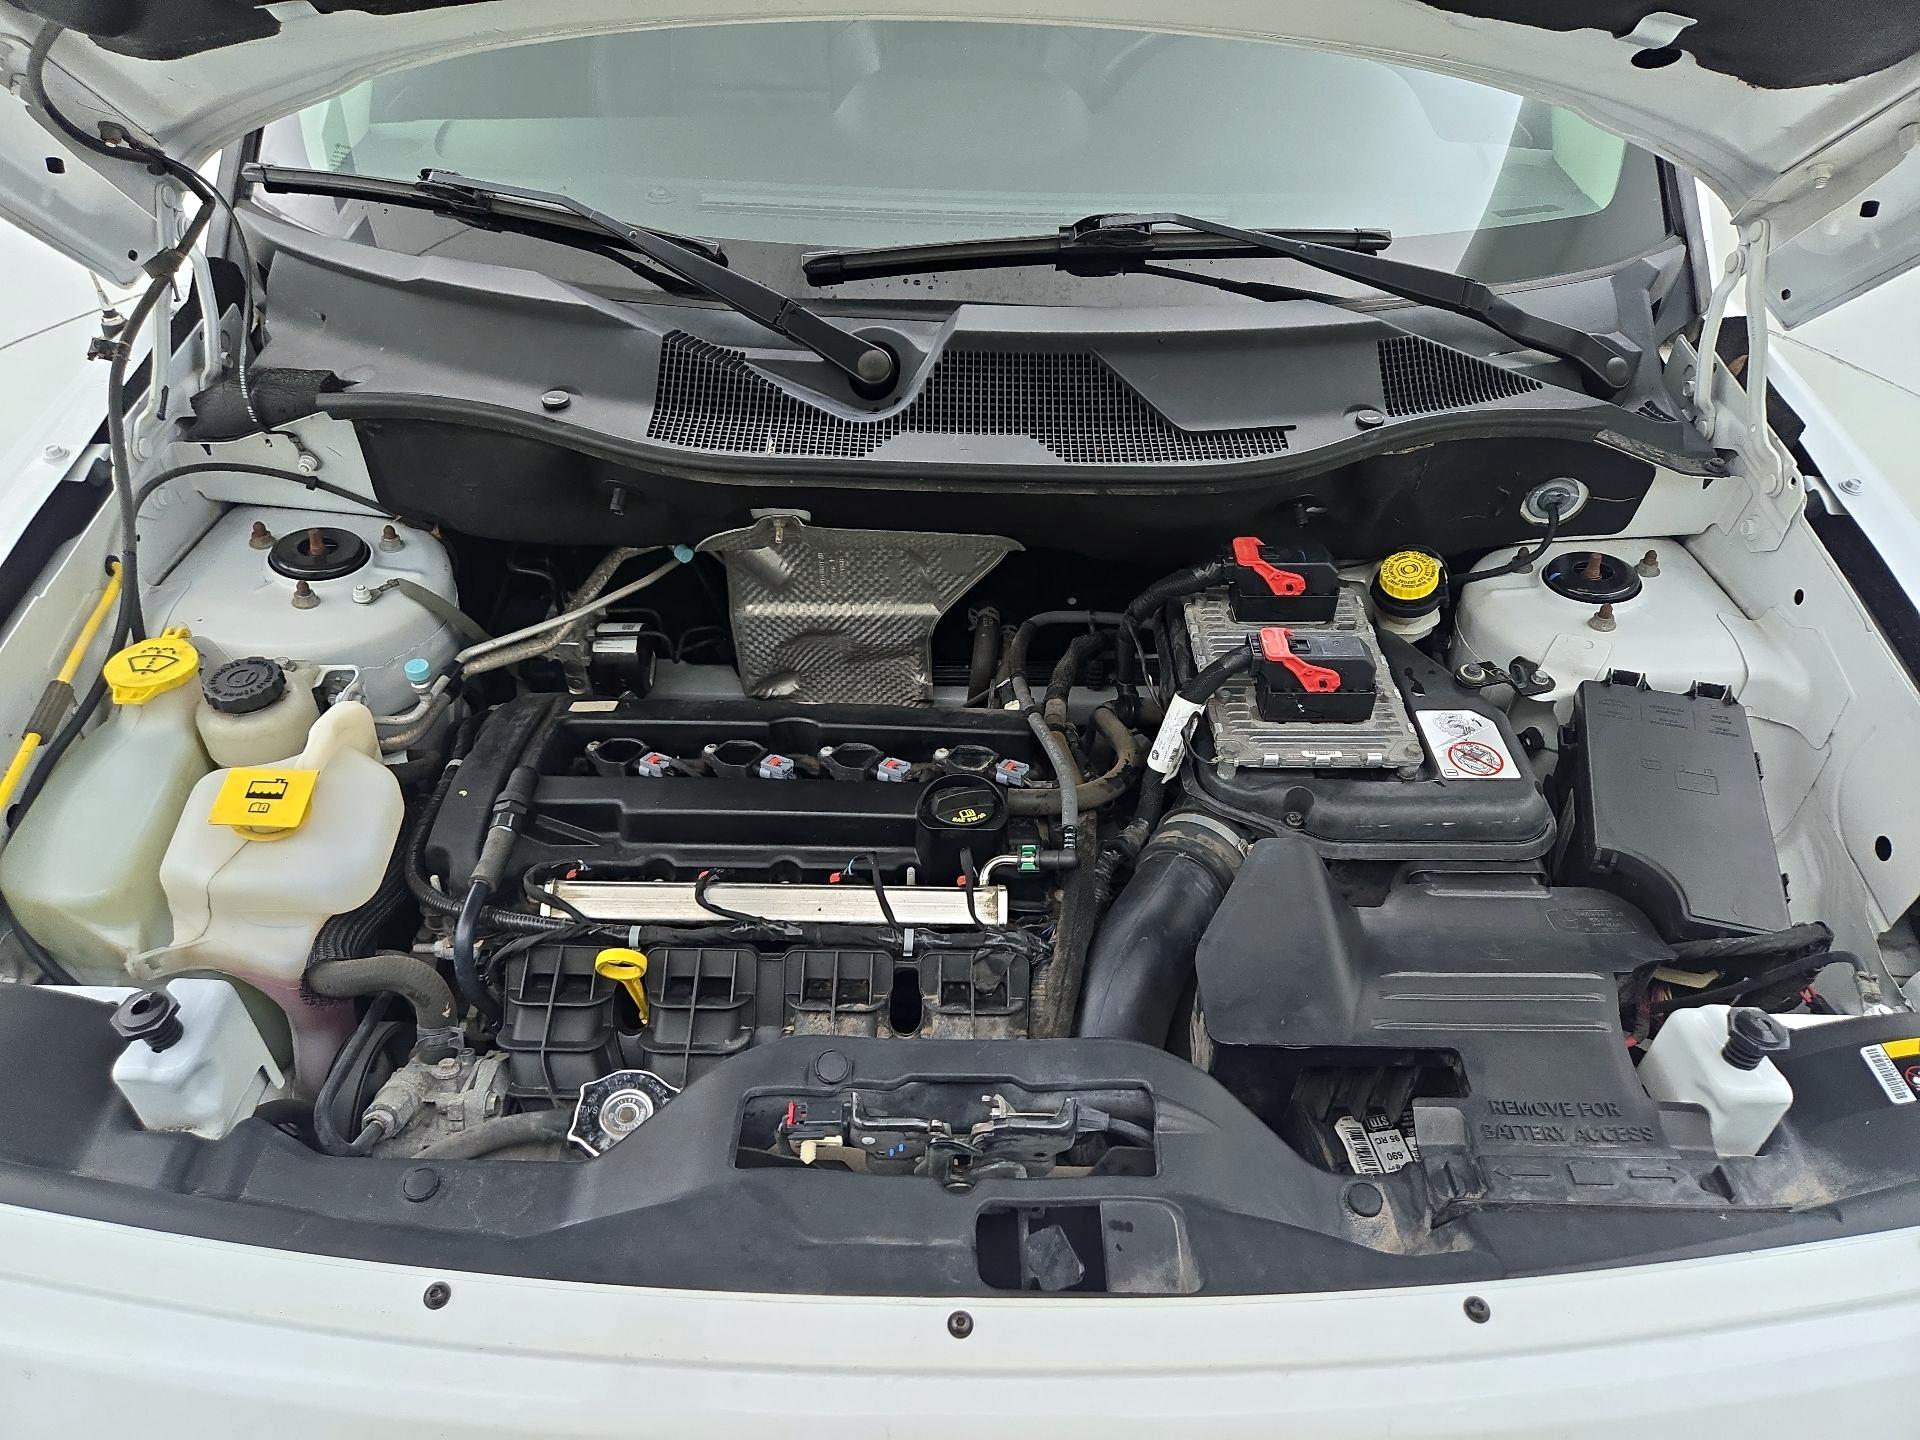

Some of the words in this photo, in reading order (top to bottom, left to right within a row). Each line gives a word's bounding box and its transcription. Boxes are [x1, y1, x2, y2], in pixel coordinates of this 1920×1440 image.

[1488, 1099, 1575, 1117] REMOVE
[1578, 1100, 1623, 1118] FOR
[1480, 1123, 1566, 1142] BATTERY
[1575, 1125, 1656, 1142] ACCESS
[1375, 1136, 1389, 1145] RC
[1386, 1151, 1404, 1161] 690
